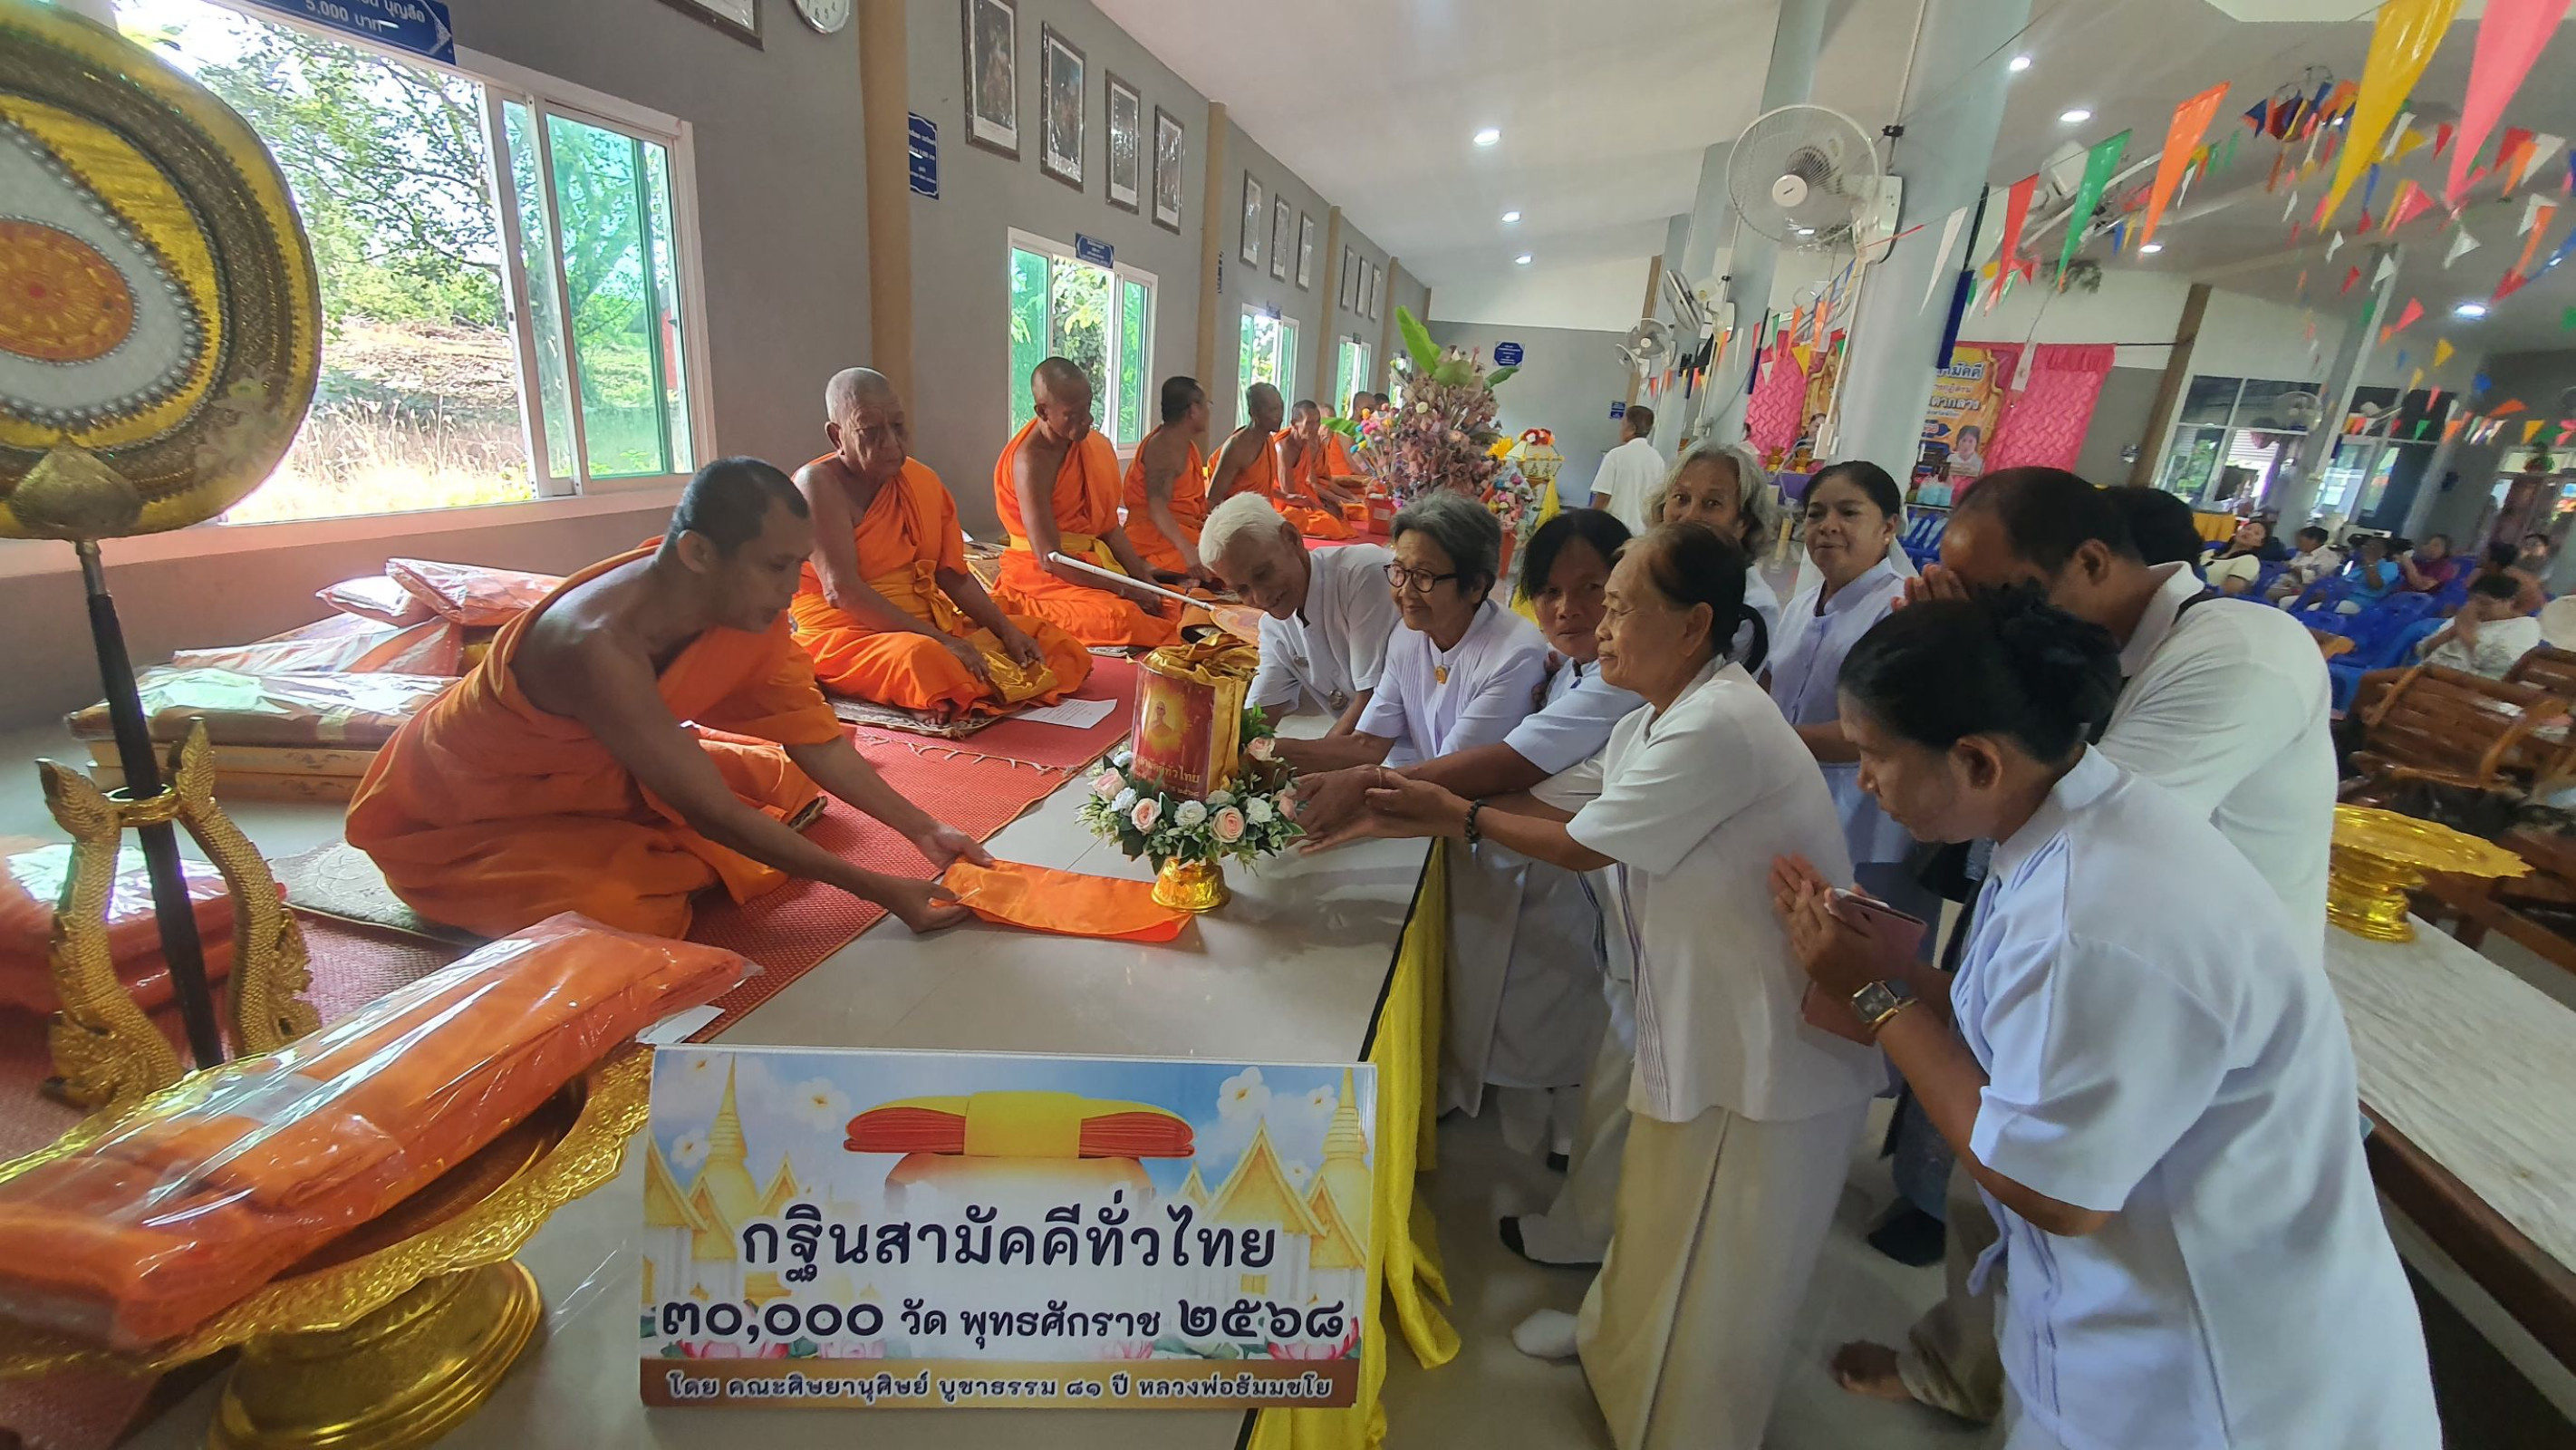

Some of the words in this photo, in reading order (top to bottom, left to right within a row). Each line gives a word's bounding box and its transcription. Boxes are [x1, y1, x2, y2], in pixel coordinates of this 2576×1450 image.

[742, 1189, 1276, 1282] กฐินสามัคคีทั่วไทย
[662, 1301, 883, 1344] ๓๐,๐๐๐
[901, 1298, 948, 1336] วัด
[960, 1300, 1161, 1349] พุทธศักราช
[1179, 1299, 1344, 1339] ๒๕๖๘
[669, 1370, 719, 1397] โดย
[728, 1371, 929, 1403] คณะศิษยานุศิษย์
[939, 1377, 1056, 1403] บูชาธรรม
[1066, 1379, 1102, 1397] ๘๑
[1112, 1372, 1130, 1397] ปี
[1139, 1373, 1332, 1397] หลวงพ่อธัมมชโย
